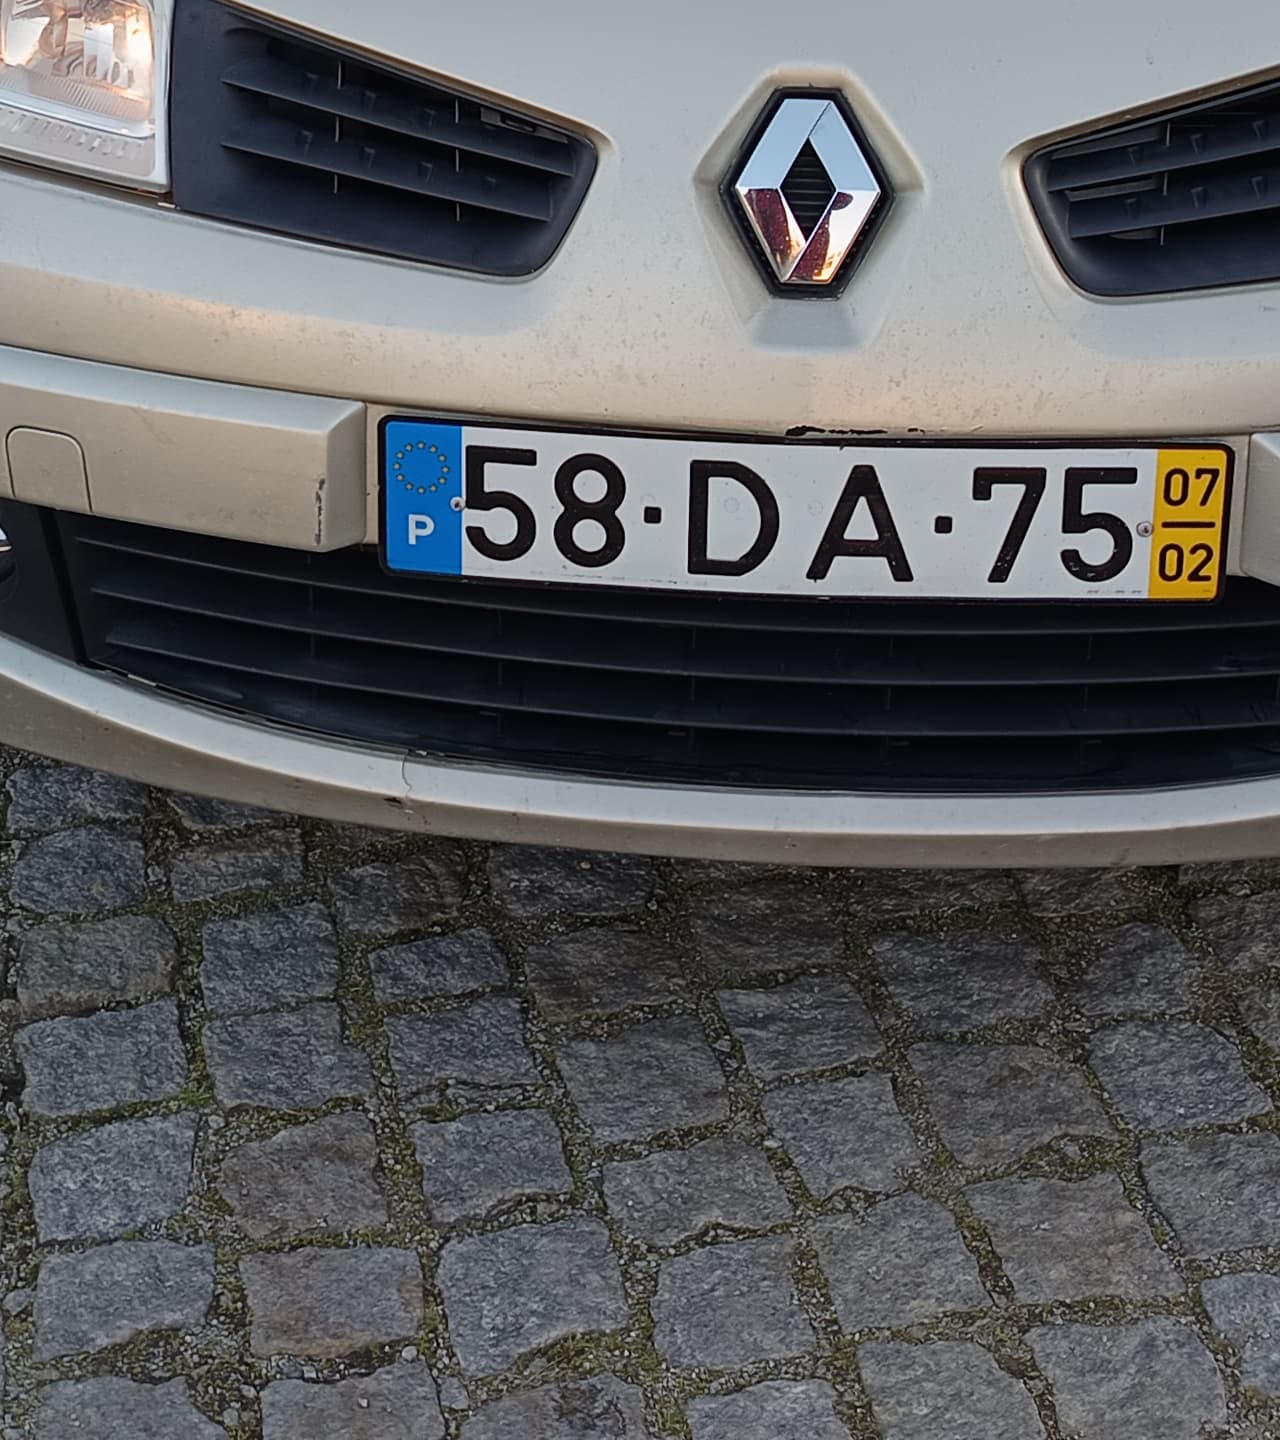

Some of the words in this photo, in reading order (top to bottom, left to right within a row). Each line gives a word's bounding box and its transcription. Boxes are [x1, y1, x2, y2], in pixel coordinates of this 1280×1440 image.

[1162, 467, 1220, 507] 07
[407, 513, 435, 545] P
[1157, 542, 1215, 583] 02
